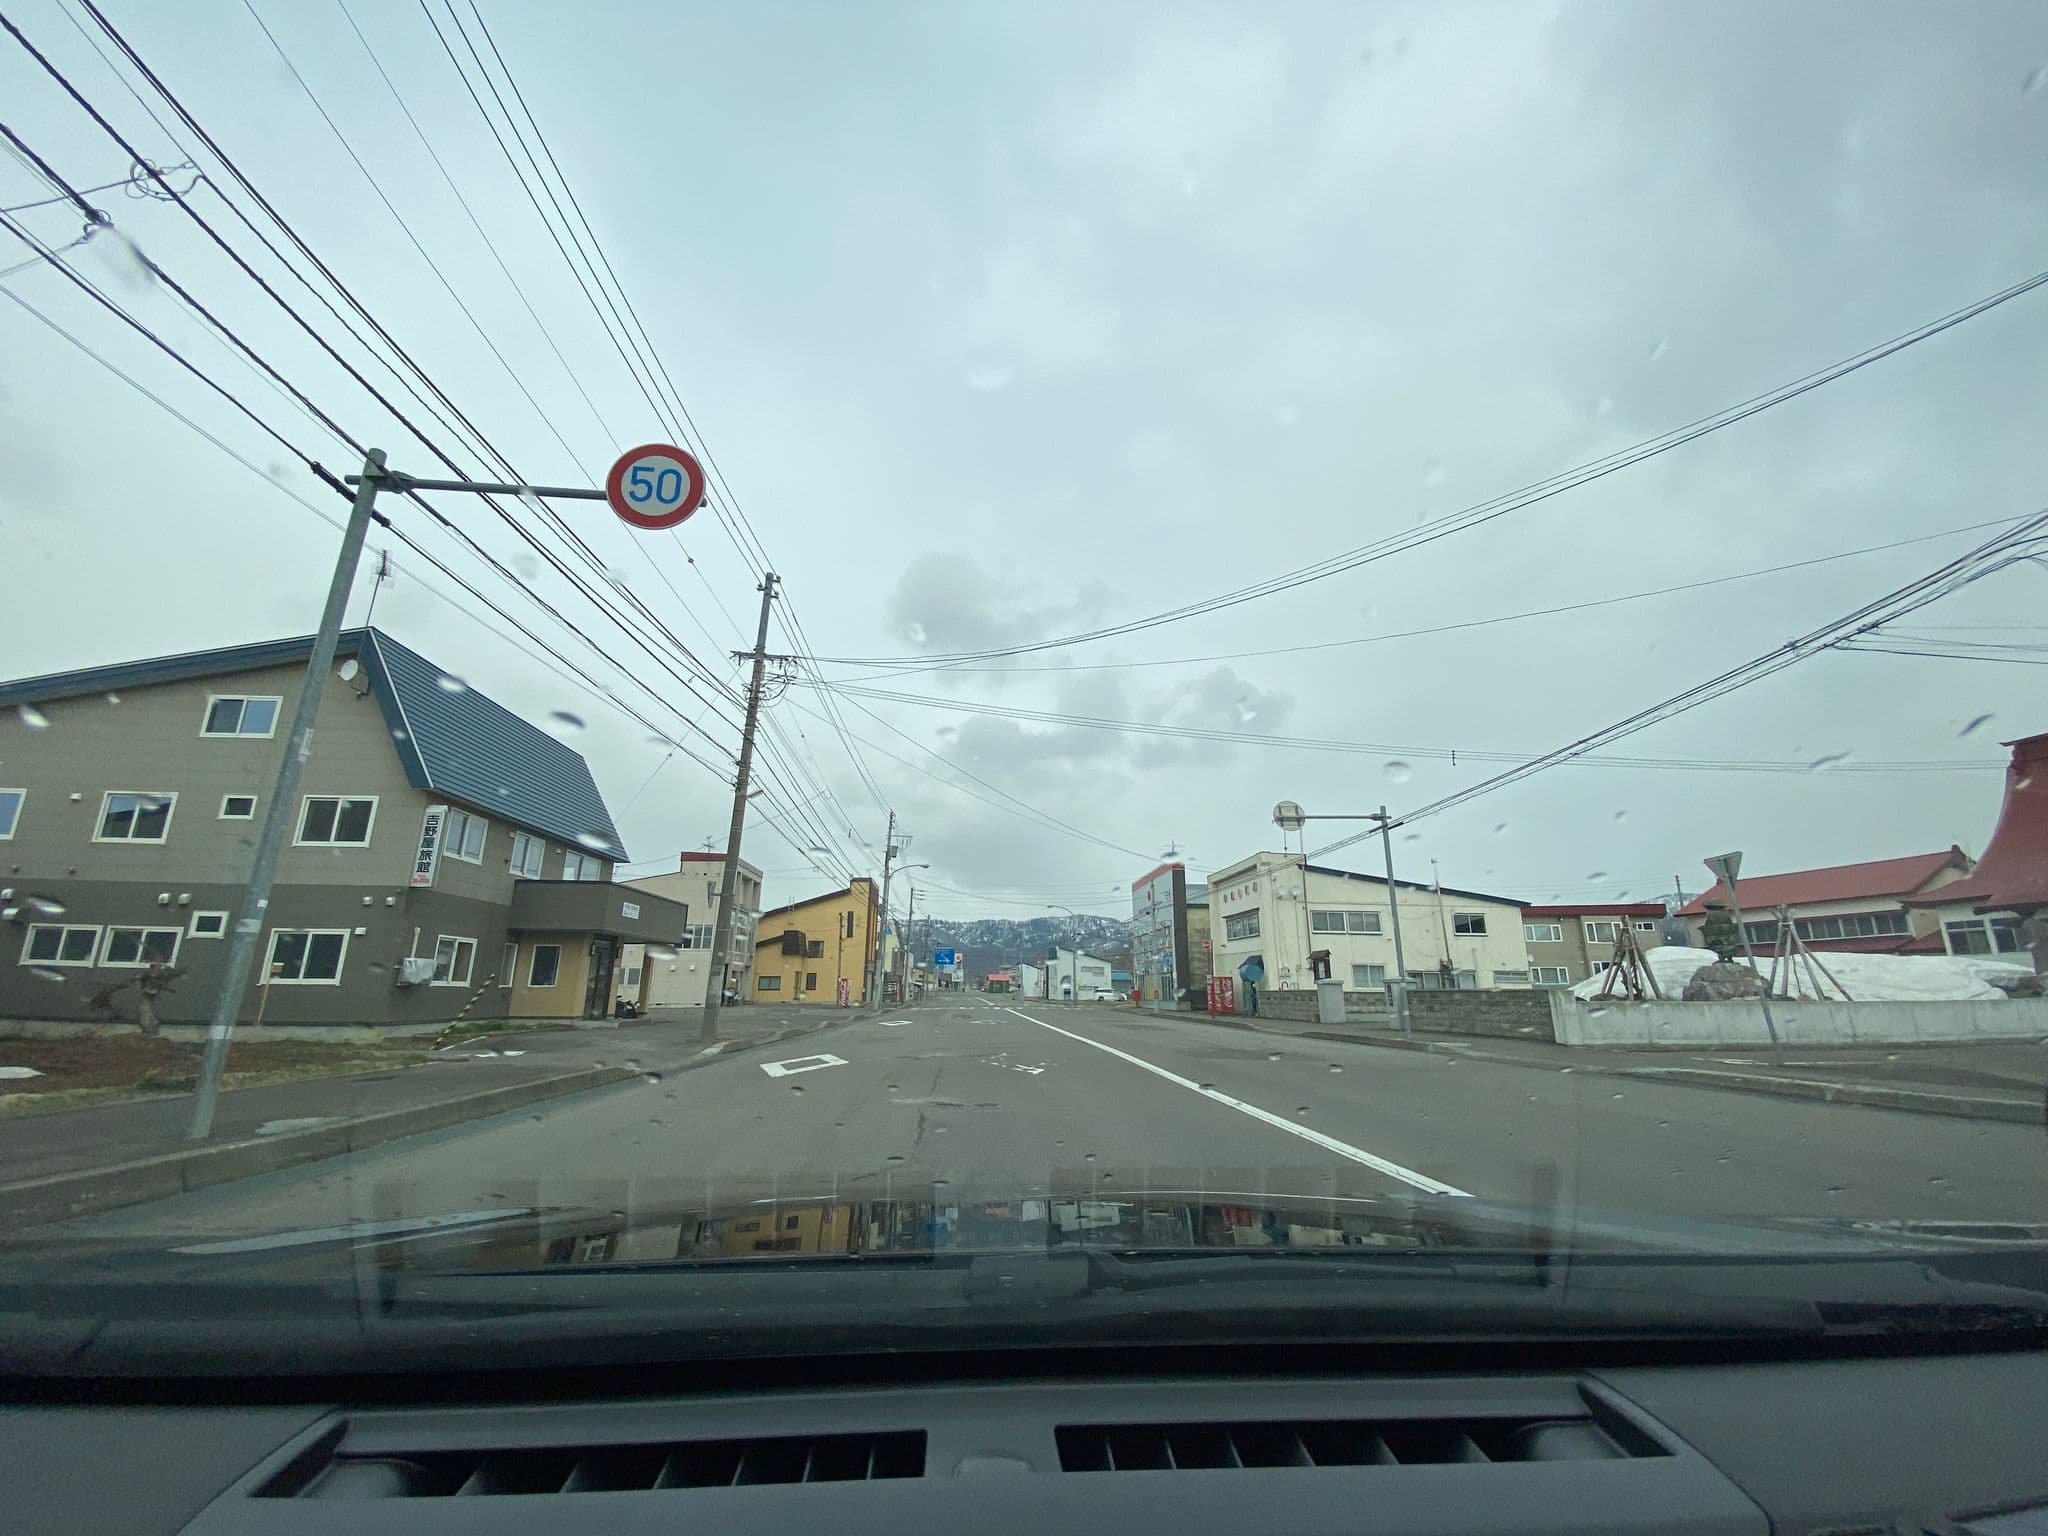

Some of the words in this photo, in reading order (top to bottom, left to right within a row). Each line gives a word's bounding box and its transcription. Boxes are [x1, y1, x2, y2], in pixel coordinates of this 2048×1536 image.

[629, 466, 682, 504] 50
[416, 814, 440, 873] 吉野屋旅館
